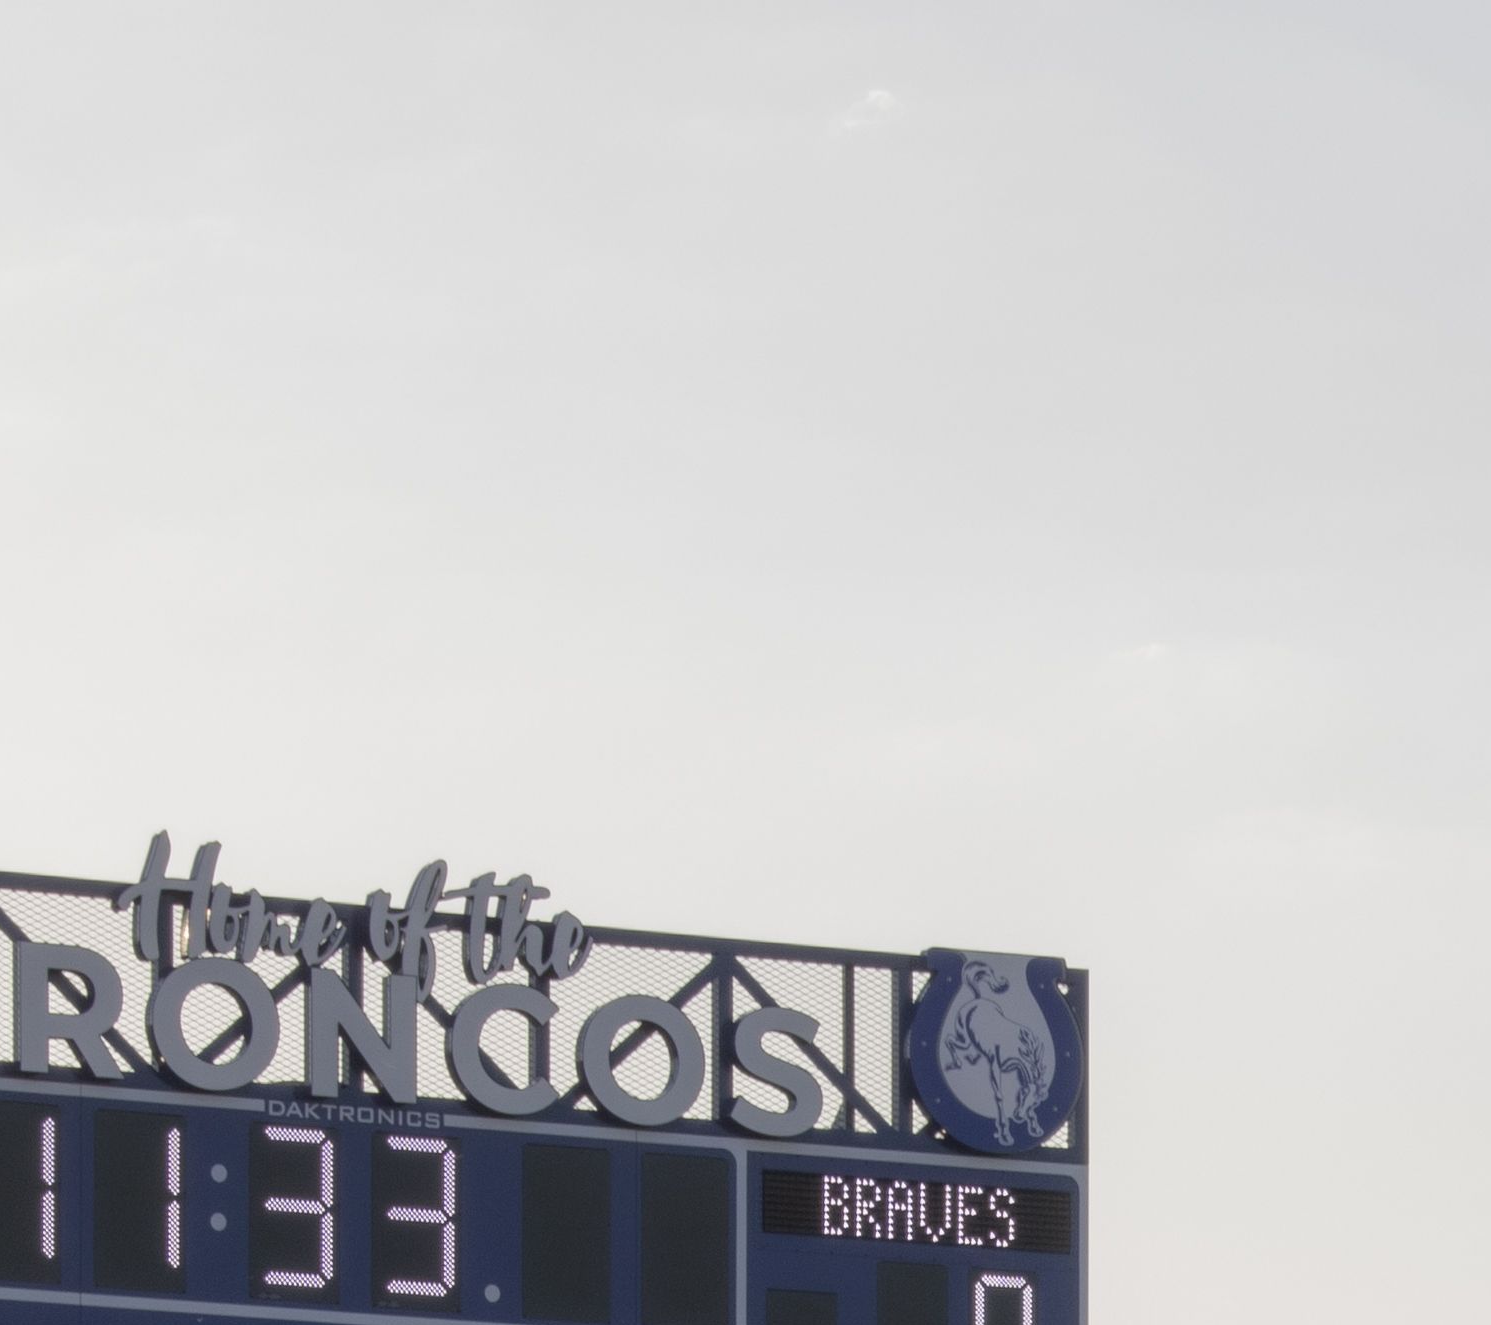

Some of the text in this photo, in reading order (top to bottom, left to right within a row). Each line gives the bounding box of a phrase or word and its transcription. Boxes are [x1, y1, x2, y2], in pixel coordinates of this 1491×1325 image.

[112, 830, 593, 1002] Home of the
[268, 1099, 442, 1129] DAKTRONICS
[821, 1174, 1016, 1248] BRAVES
